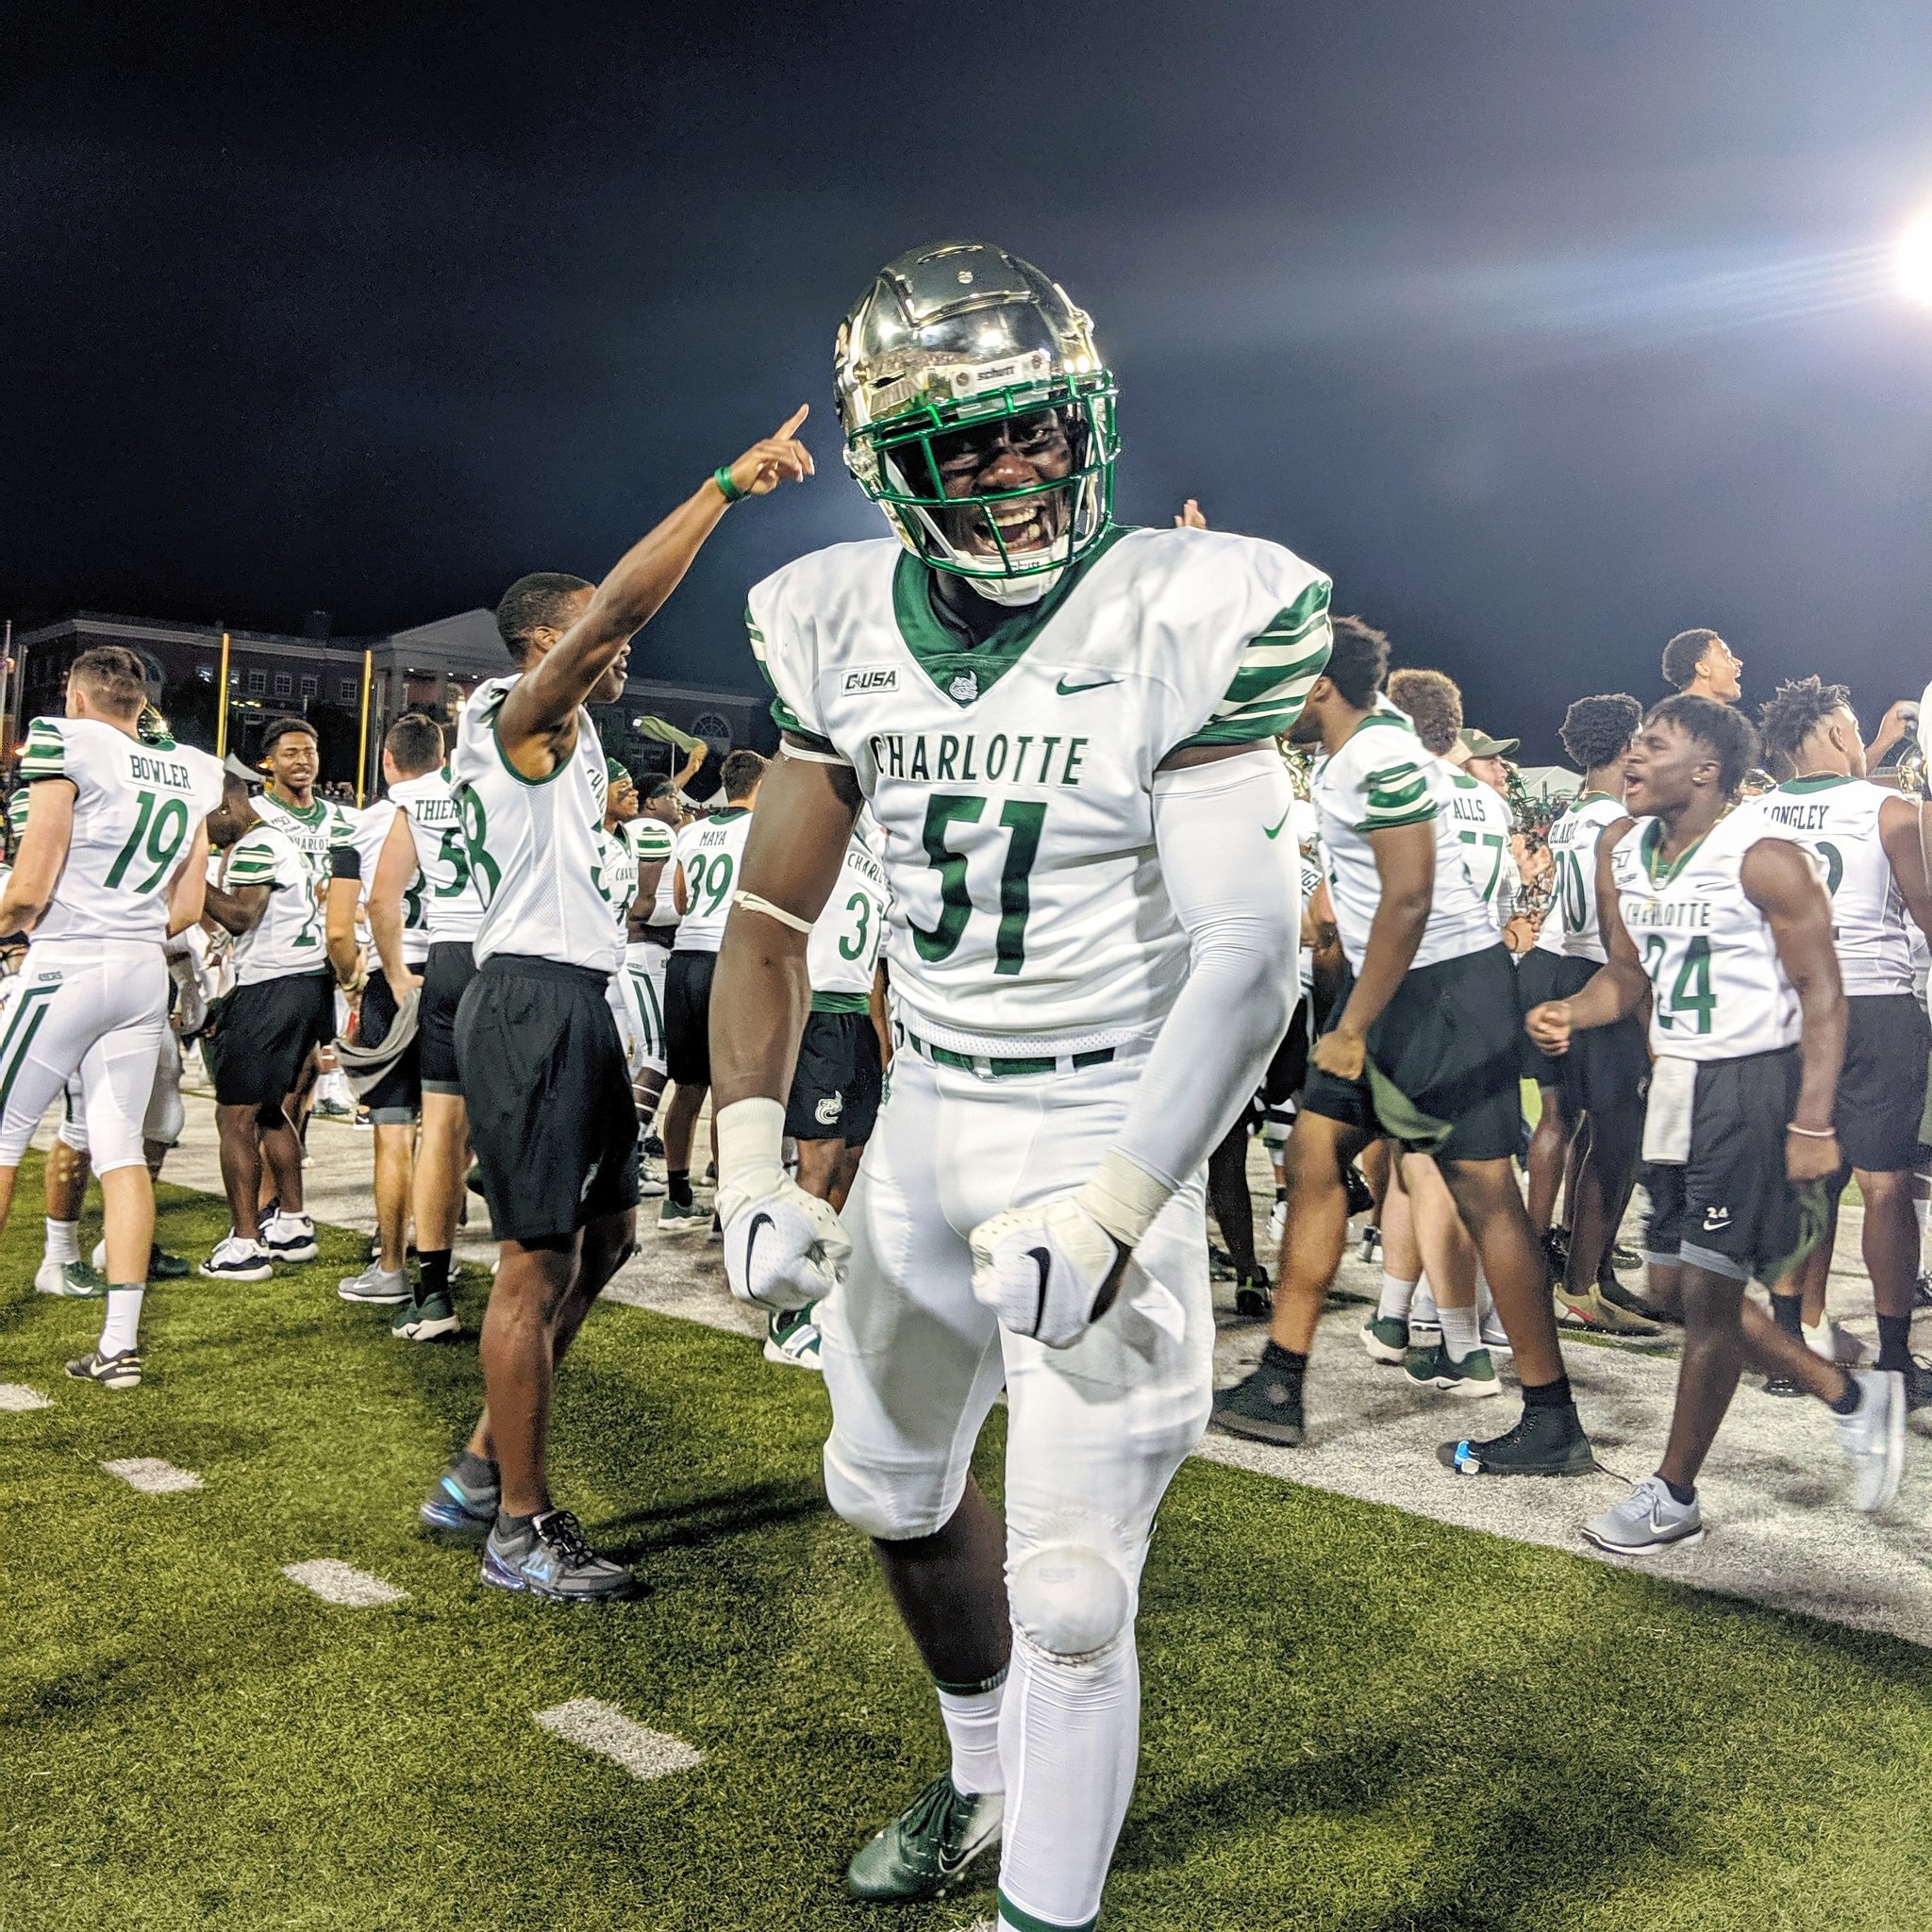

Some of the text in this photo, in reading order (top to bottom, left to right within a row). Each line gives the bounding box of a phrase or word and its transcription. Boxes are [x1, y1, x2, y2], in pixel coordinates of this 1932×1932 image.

[129, 755, 191, 790] BOWLER
[869, 733, 1090, 786] CHARLOTTE
[1453, 797, 1486, 822] ALLS
[103, 791, 188, 894] 19
[699, 831, 727, 847] MAYA
[685, 853, 734, 918] 39
[906, 792, 1048, 975] 51
[1641, 935, 1717, 1035] 24
[1706, 1207, 1729, 1219] 24
